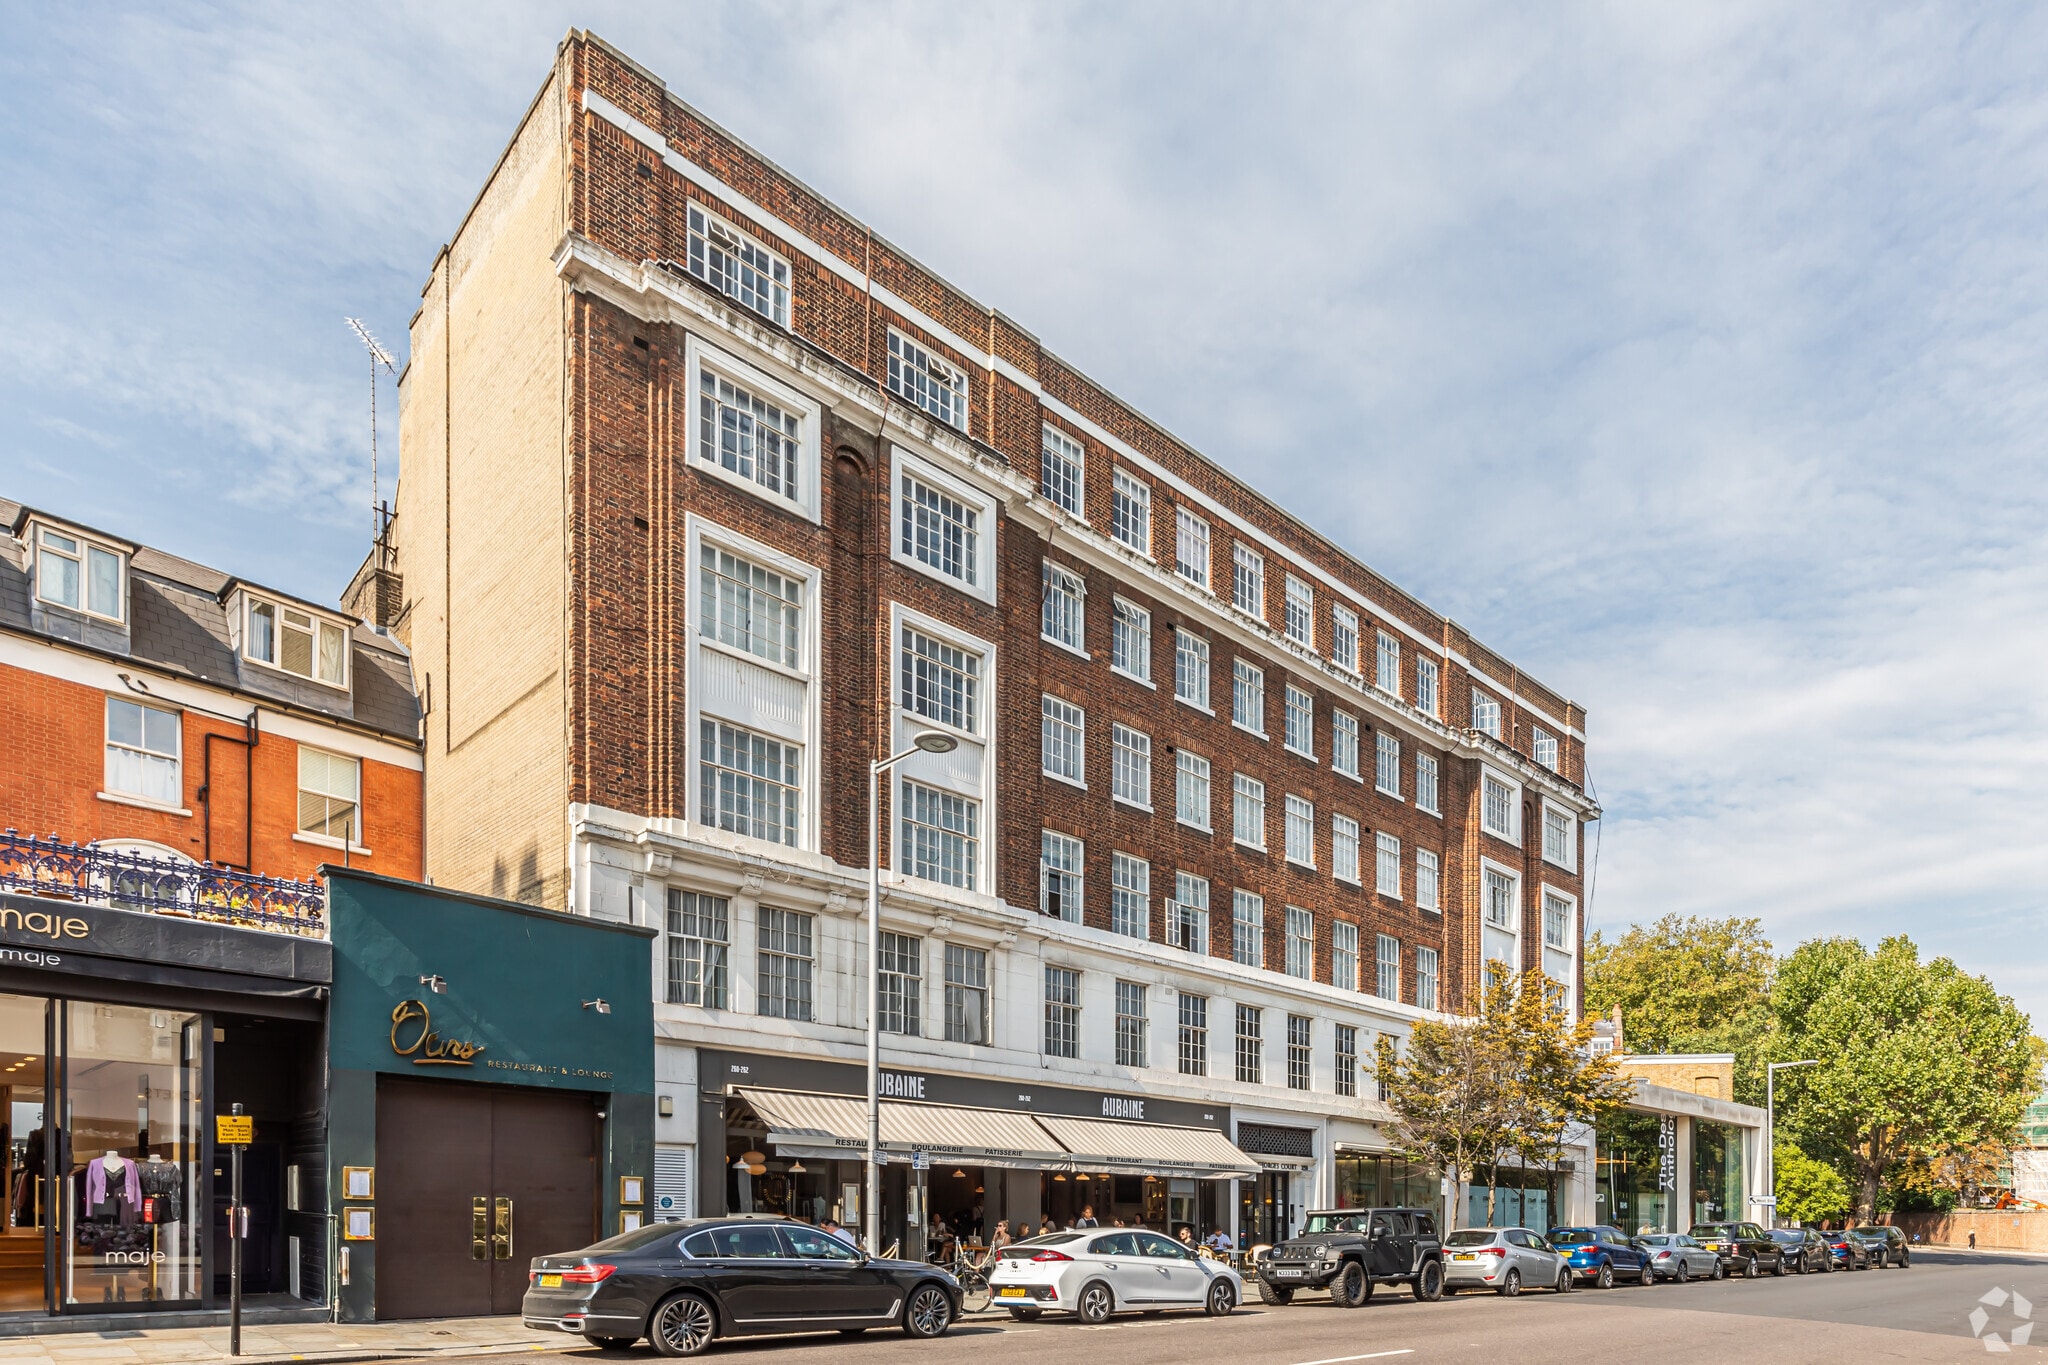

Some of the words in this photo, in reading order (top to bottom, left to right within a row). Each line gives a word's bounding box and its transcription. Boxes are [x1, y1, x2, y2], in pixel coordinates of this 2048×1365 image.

[0, 908, 89, 939] maje
[0, 949, 60, 966] maje
[390, 1000, 486, 1060] Ours
[487, 1060, 557, 1074] RESTAURANT
[561, 1066, 568, 1075] &
[572, 1068, 614, 1079] LOUNGE
[731, 1065, 749, 1073] 260-262
[868, 1072, 925, 1098] UBAINE
[1102, 1097, 1144, 1119] AUBAINE
[835, 1139, 889, 1149] RESTAUNT
[911, 1144, 964, 1153] BOULANGERIE
[984, 1149, 1023, 1157] PATISSERIE
[1106, 1156, 1143, 1164] RESTAURANT
[1659, 1155, 1667, 1190] The
[105, 1248, 165, 1265] maje
